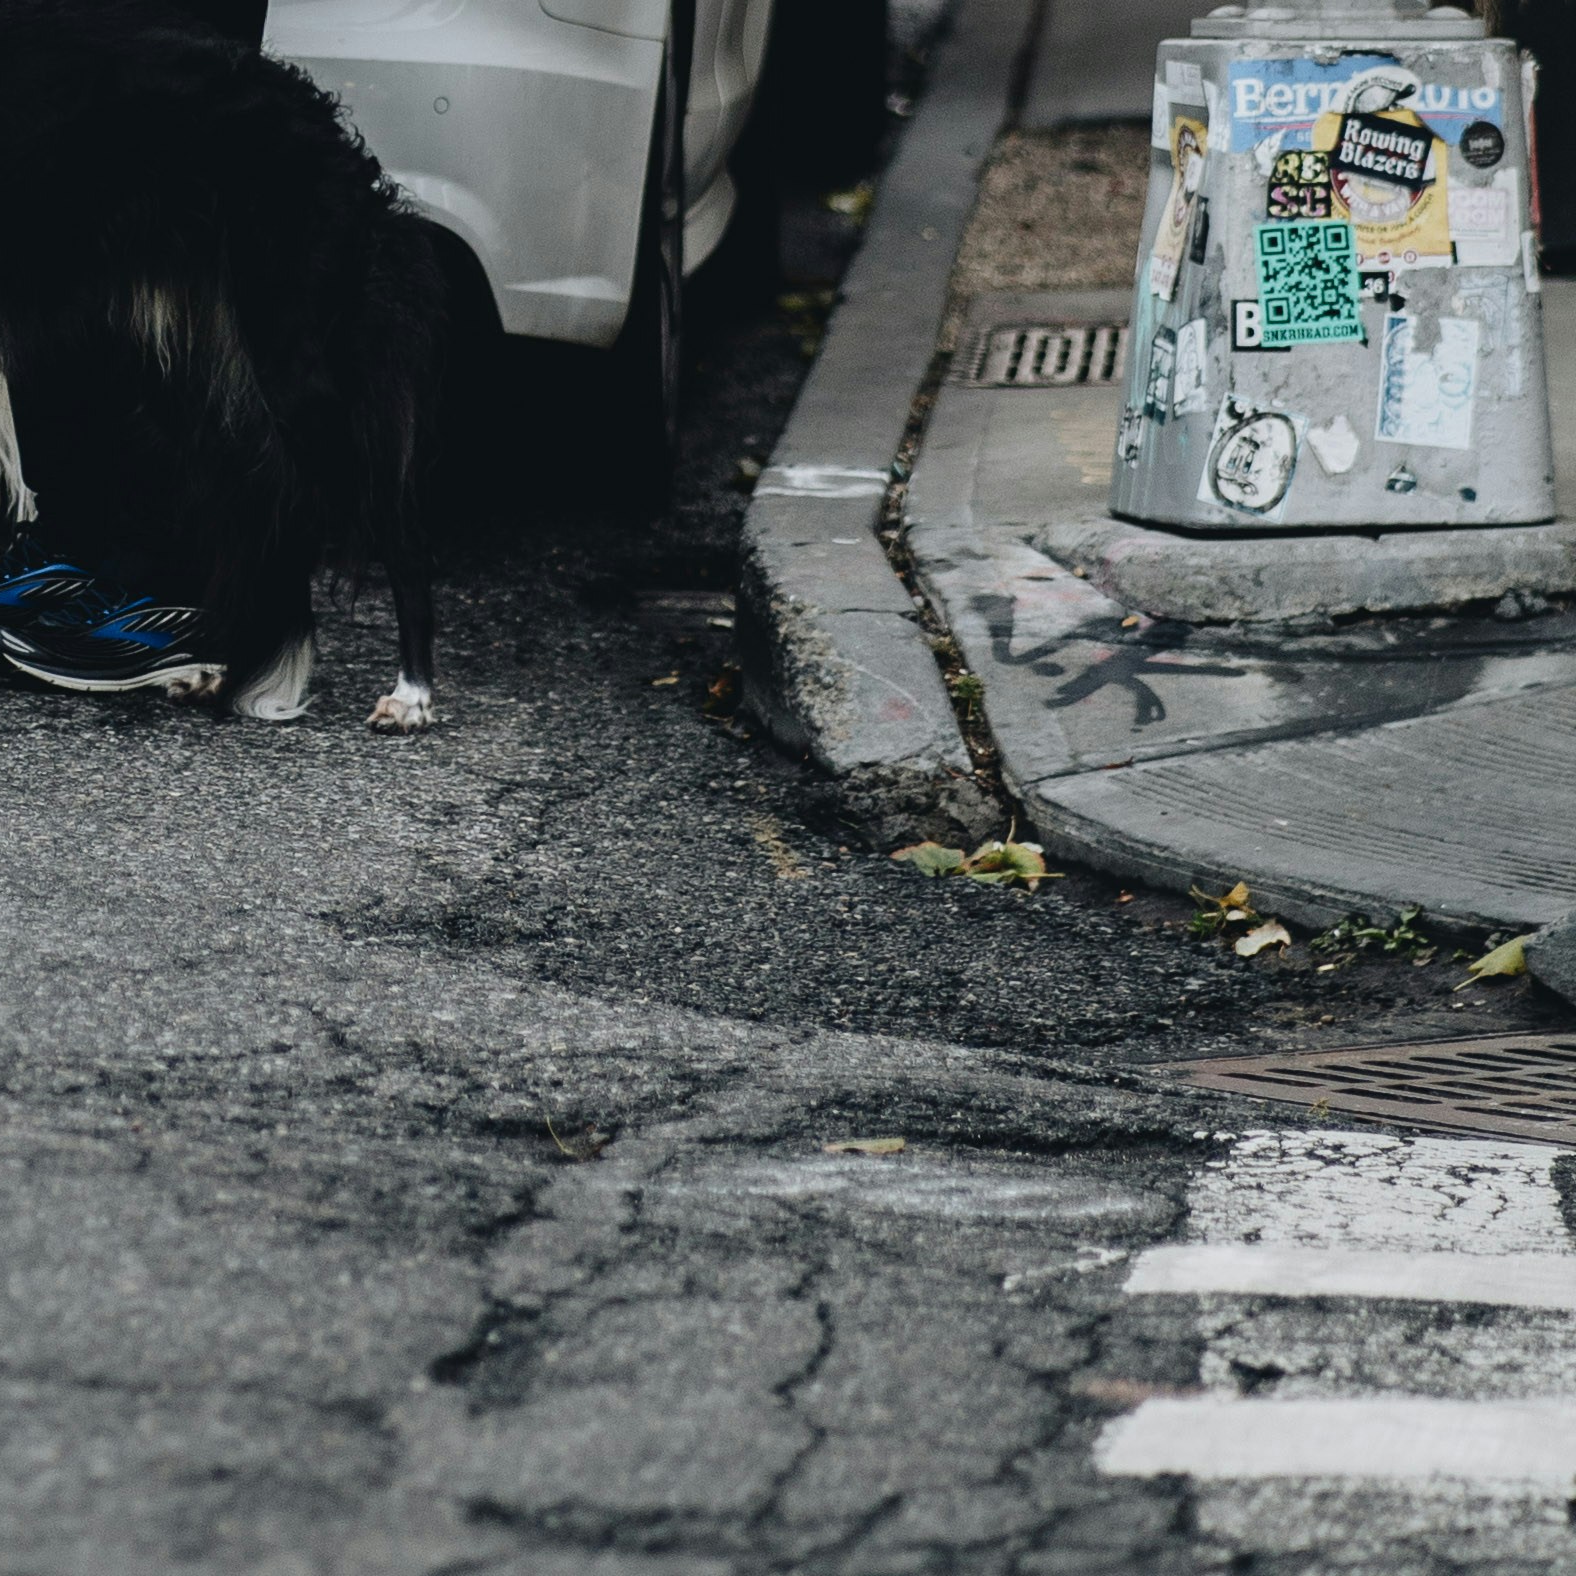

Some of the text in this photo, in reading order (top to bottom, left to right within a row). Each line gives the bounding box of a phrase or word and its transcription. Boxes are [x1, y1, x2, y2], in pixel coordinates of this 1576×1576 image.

[1232, 78, 1349, 118] Bern
[1343, 118, 1427, 161] Rowing
[1339, 140, 1422, 181] Blazers
[1363, 277, 1385, 294] 36
[1261, 324, 1360, 344] SNKRHEAD.COM
